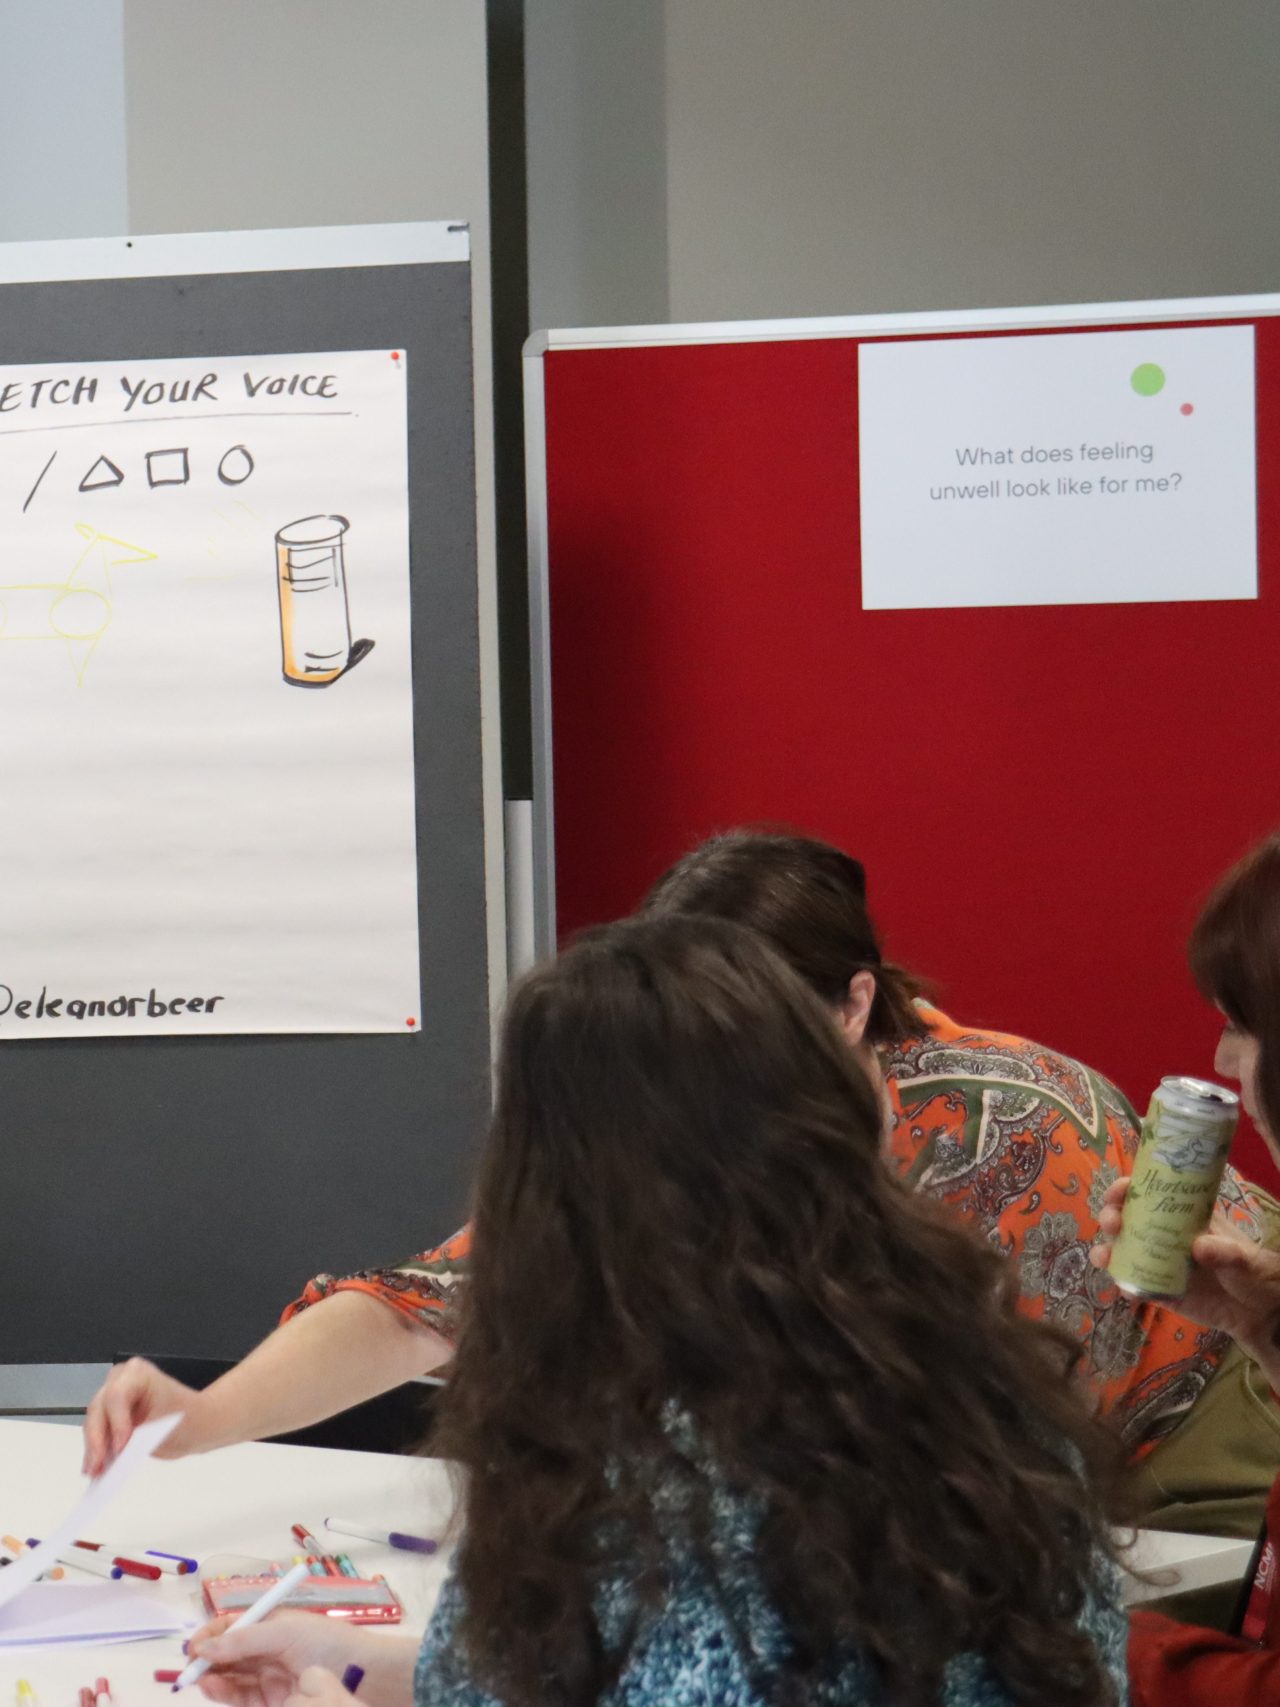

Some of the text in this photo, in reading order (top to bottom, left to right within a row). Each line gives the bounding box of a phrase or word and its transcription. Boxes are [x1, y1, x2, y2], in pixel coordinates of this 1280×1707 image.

[119, 373, 219, 412] YOUR
[243, 372, 339, 398] VOICE
[955, 442, 1154, 466] What does feeling
[930, 472, 1182, 500] unwell look like for me?
[1254, 1542, 1273, 1590] NCM
